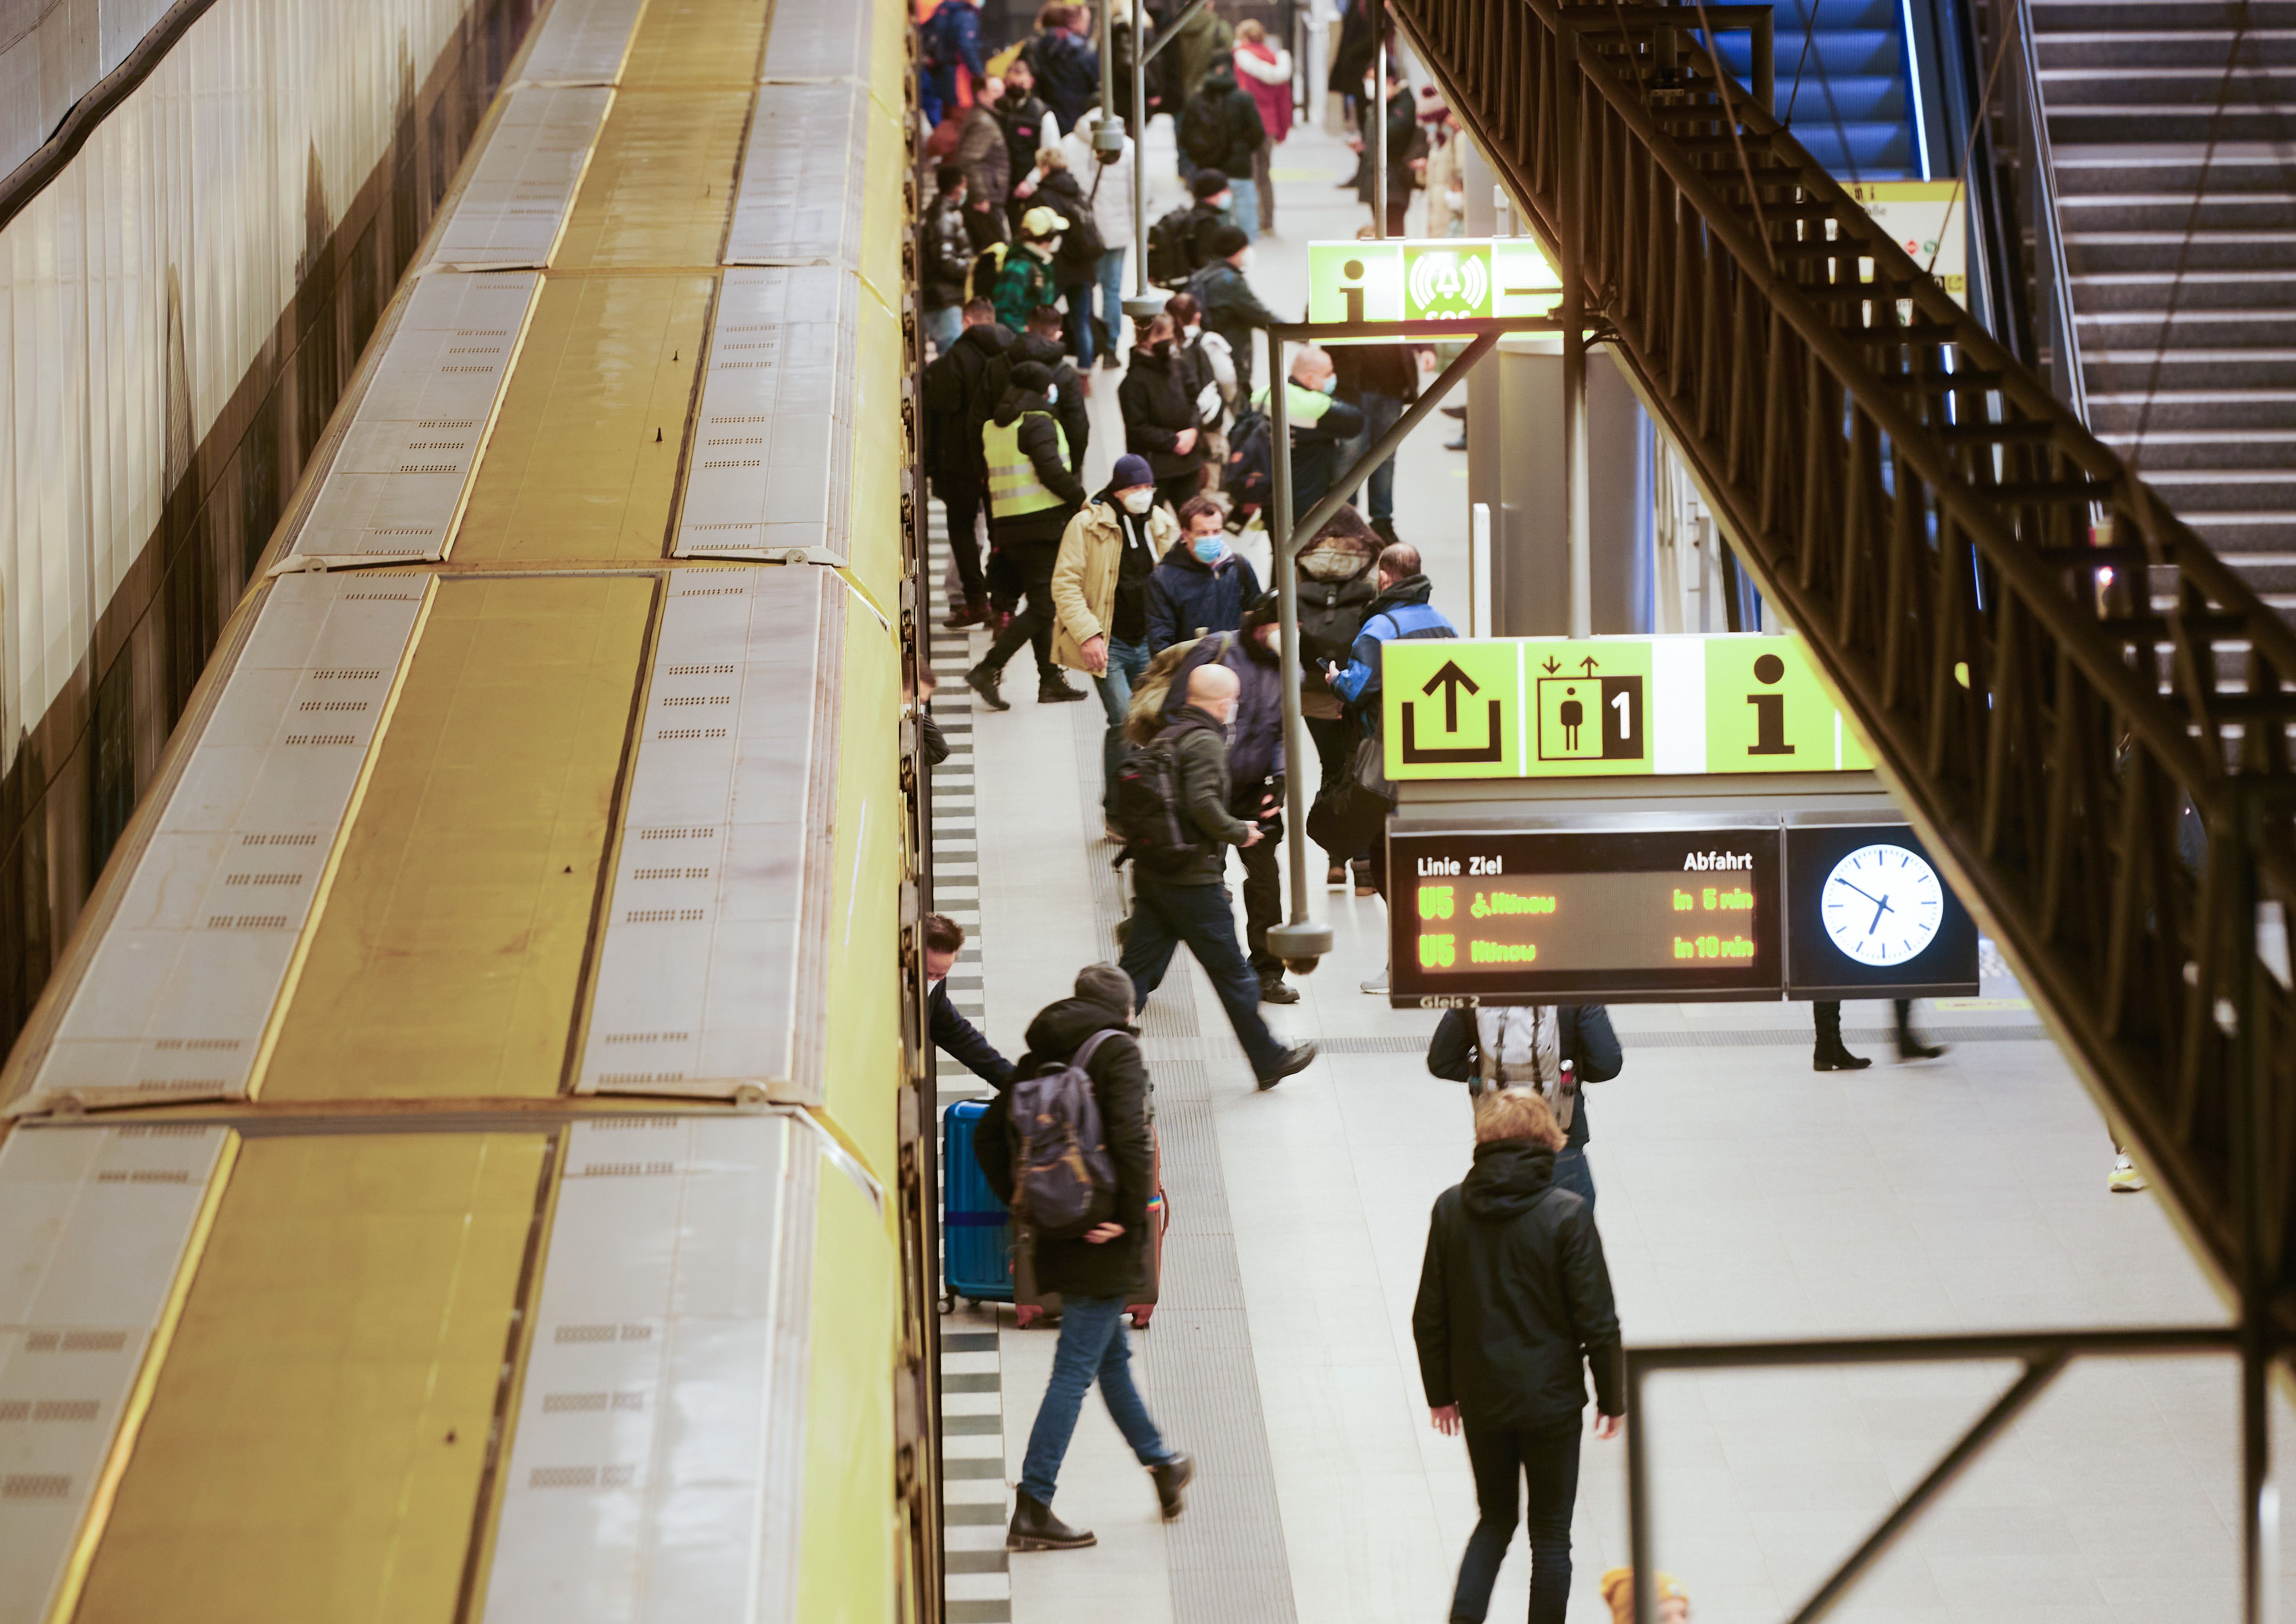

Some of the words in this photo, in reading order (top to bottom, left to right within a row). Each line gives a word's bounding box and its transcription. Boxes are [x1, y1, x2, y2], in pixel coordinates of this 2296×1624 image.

[1611, 691, 1630, 739] 1
[1418, 856, 1461, 876] Linie
[1469, 855, 1502, 875] Ziel
[1684, 851, 1752, 871] Abfahrt
[1419, 886, 1453, 919] U5
[1674, 889, 1693, 910] in
[1703, 889, 1716, 910] 5
[1720, 888, 1753, 909] min
[1420, 935, 1455, 967] U5
[1675, 937, 1693, 958] in
[1696, 936, 1719, 958] 10
[1721, 936, 1754, 957] min
[1420, 995, 1464, 1008] Gleis
[1469, 995, 1480, 1008] 2
